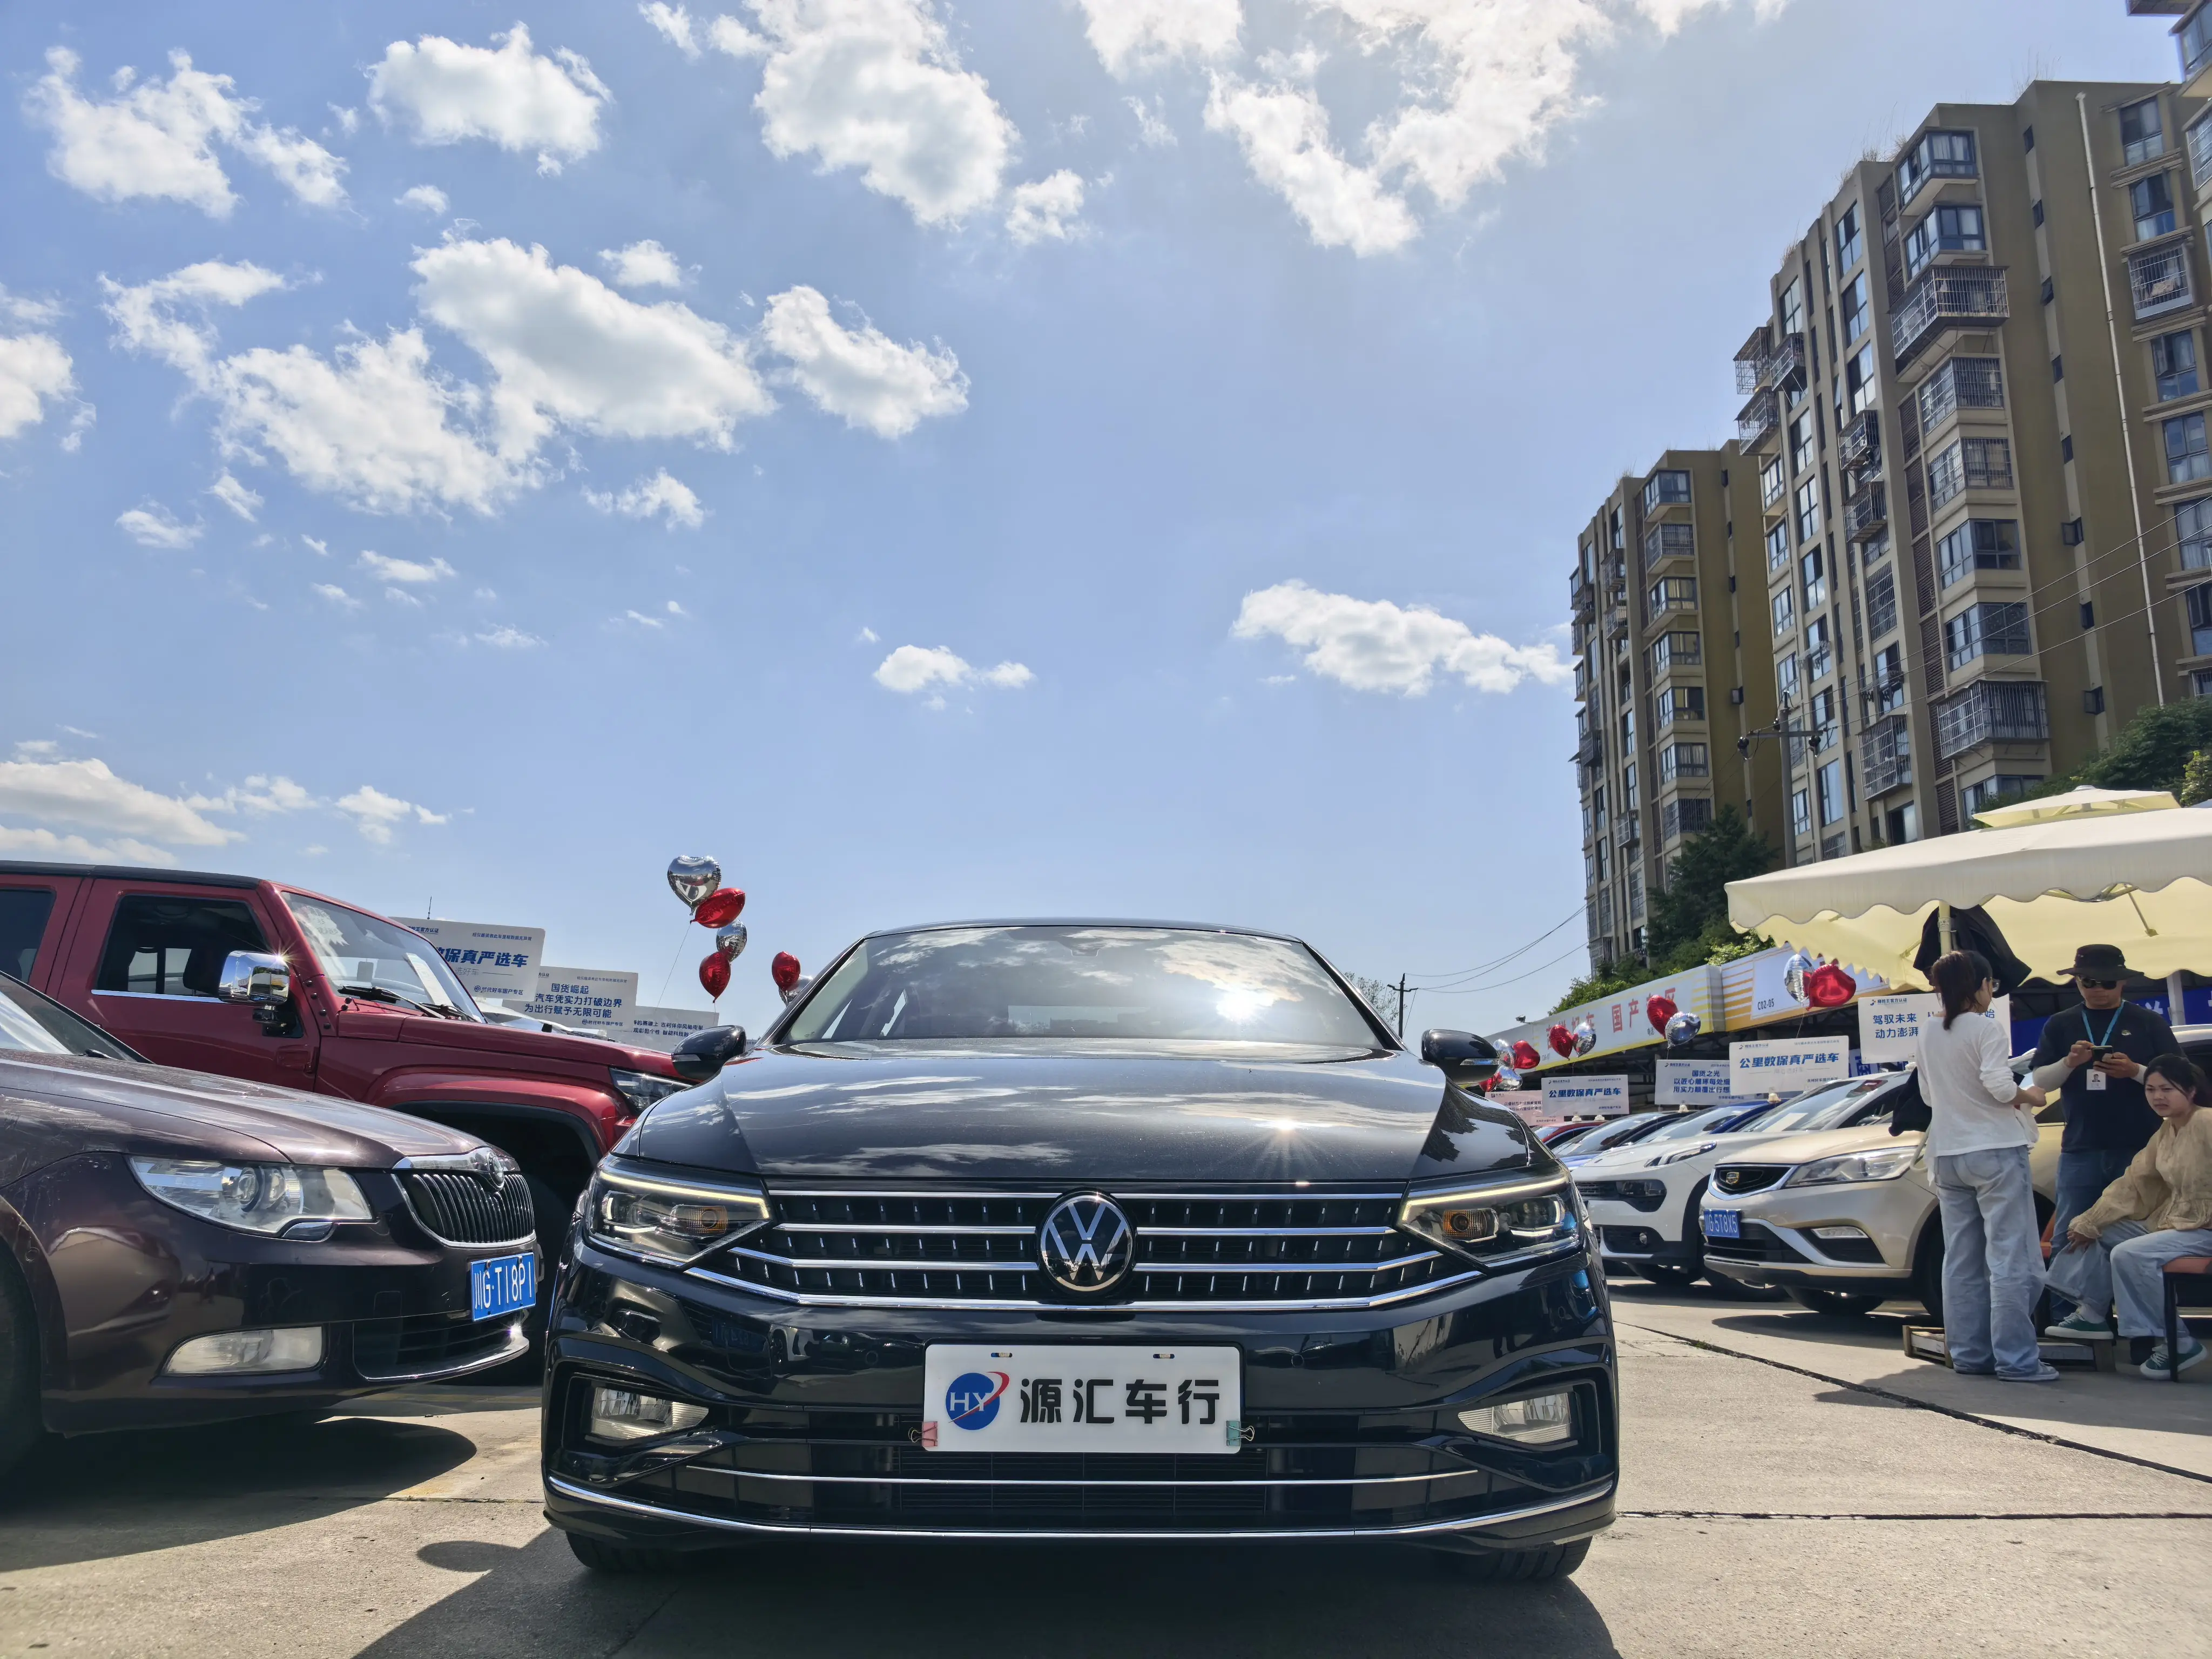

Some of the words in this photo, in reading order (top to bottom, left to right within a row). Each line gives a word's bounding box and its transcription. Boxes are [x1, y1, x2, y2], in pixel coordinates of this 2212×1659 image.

[551, 983, 589, 994] 国货崛起
[535, 993, 622, 1008] 汽车凭实力打破边界
[1757, 998, 1775, 1010] C02-05
[524, 1003, 612, 1019] 为出行赋予无限可能
[1873, 1013, 1917, 1026] 驾驭未来
[1875, 1027, 1919, 1039] 动力澎湃
[1739, 1053, 1839, 1069] 公里数保真严选车
[1549, 1088, 1622, 1098] 公里数保真严选车
[950, 1392, 990, 1412] HY
[1020, 1378, 1220, 1425] 源汇车行
